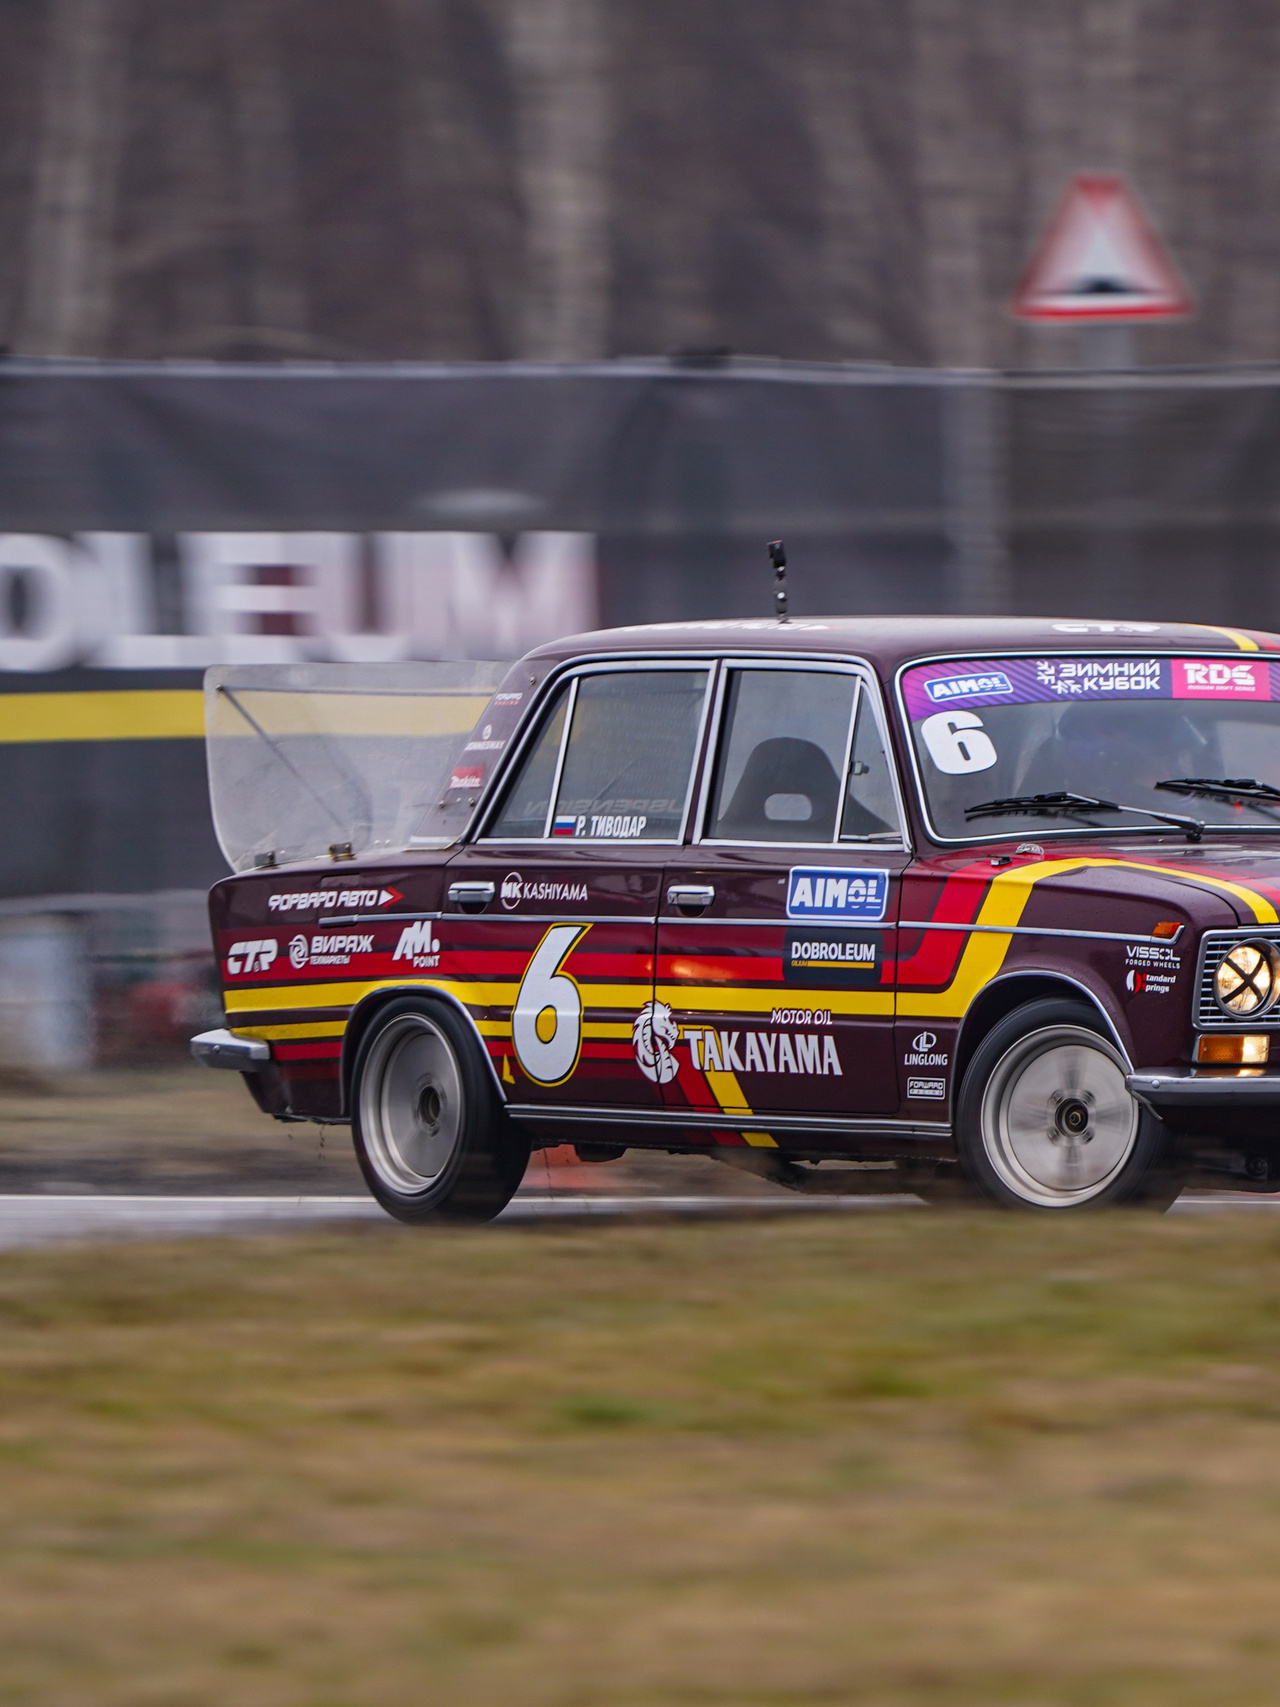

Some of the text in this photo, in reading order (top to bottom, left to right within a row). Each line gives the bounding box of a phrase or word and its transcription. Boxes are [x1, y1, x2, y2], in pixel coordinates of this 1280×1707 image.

[1059, 659, 1161, 677] ЗИМНИЙ
[1183, 663, 1256, 686] RDS
[933, 674, 1009, 698] AIMOL
[1083, 676, 1161, 691] КУБОК
[920, 710, 998, 775] 6
[575, 815, 647, 838] Р. ТИВОДАР
[522, 882, 588, 901] KASHIYAMA
[790, 877, 882, 909] AIMOL
[311, 934, 375, 954] ВИРАЖ
[791, 941, 876, 961] DOBROLEUM
[1126, 945, 1181, 961] VISSOL
[227, 938, 278, 975] CTR
[413, 955, 440, 968] POINT
[1125, 958, 1180, 969] FORGED WHEELS
[511, 922, 595, 1088] 6
[770, 1010, 833, 1025] MOTOR OIL
[683, 1030, 843, 1075] TAKAYAMA
[904, 1053, 948, 1066] LINGLONG
[909, 1080, 944, 1090] FORWARD
